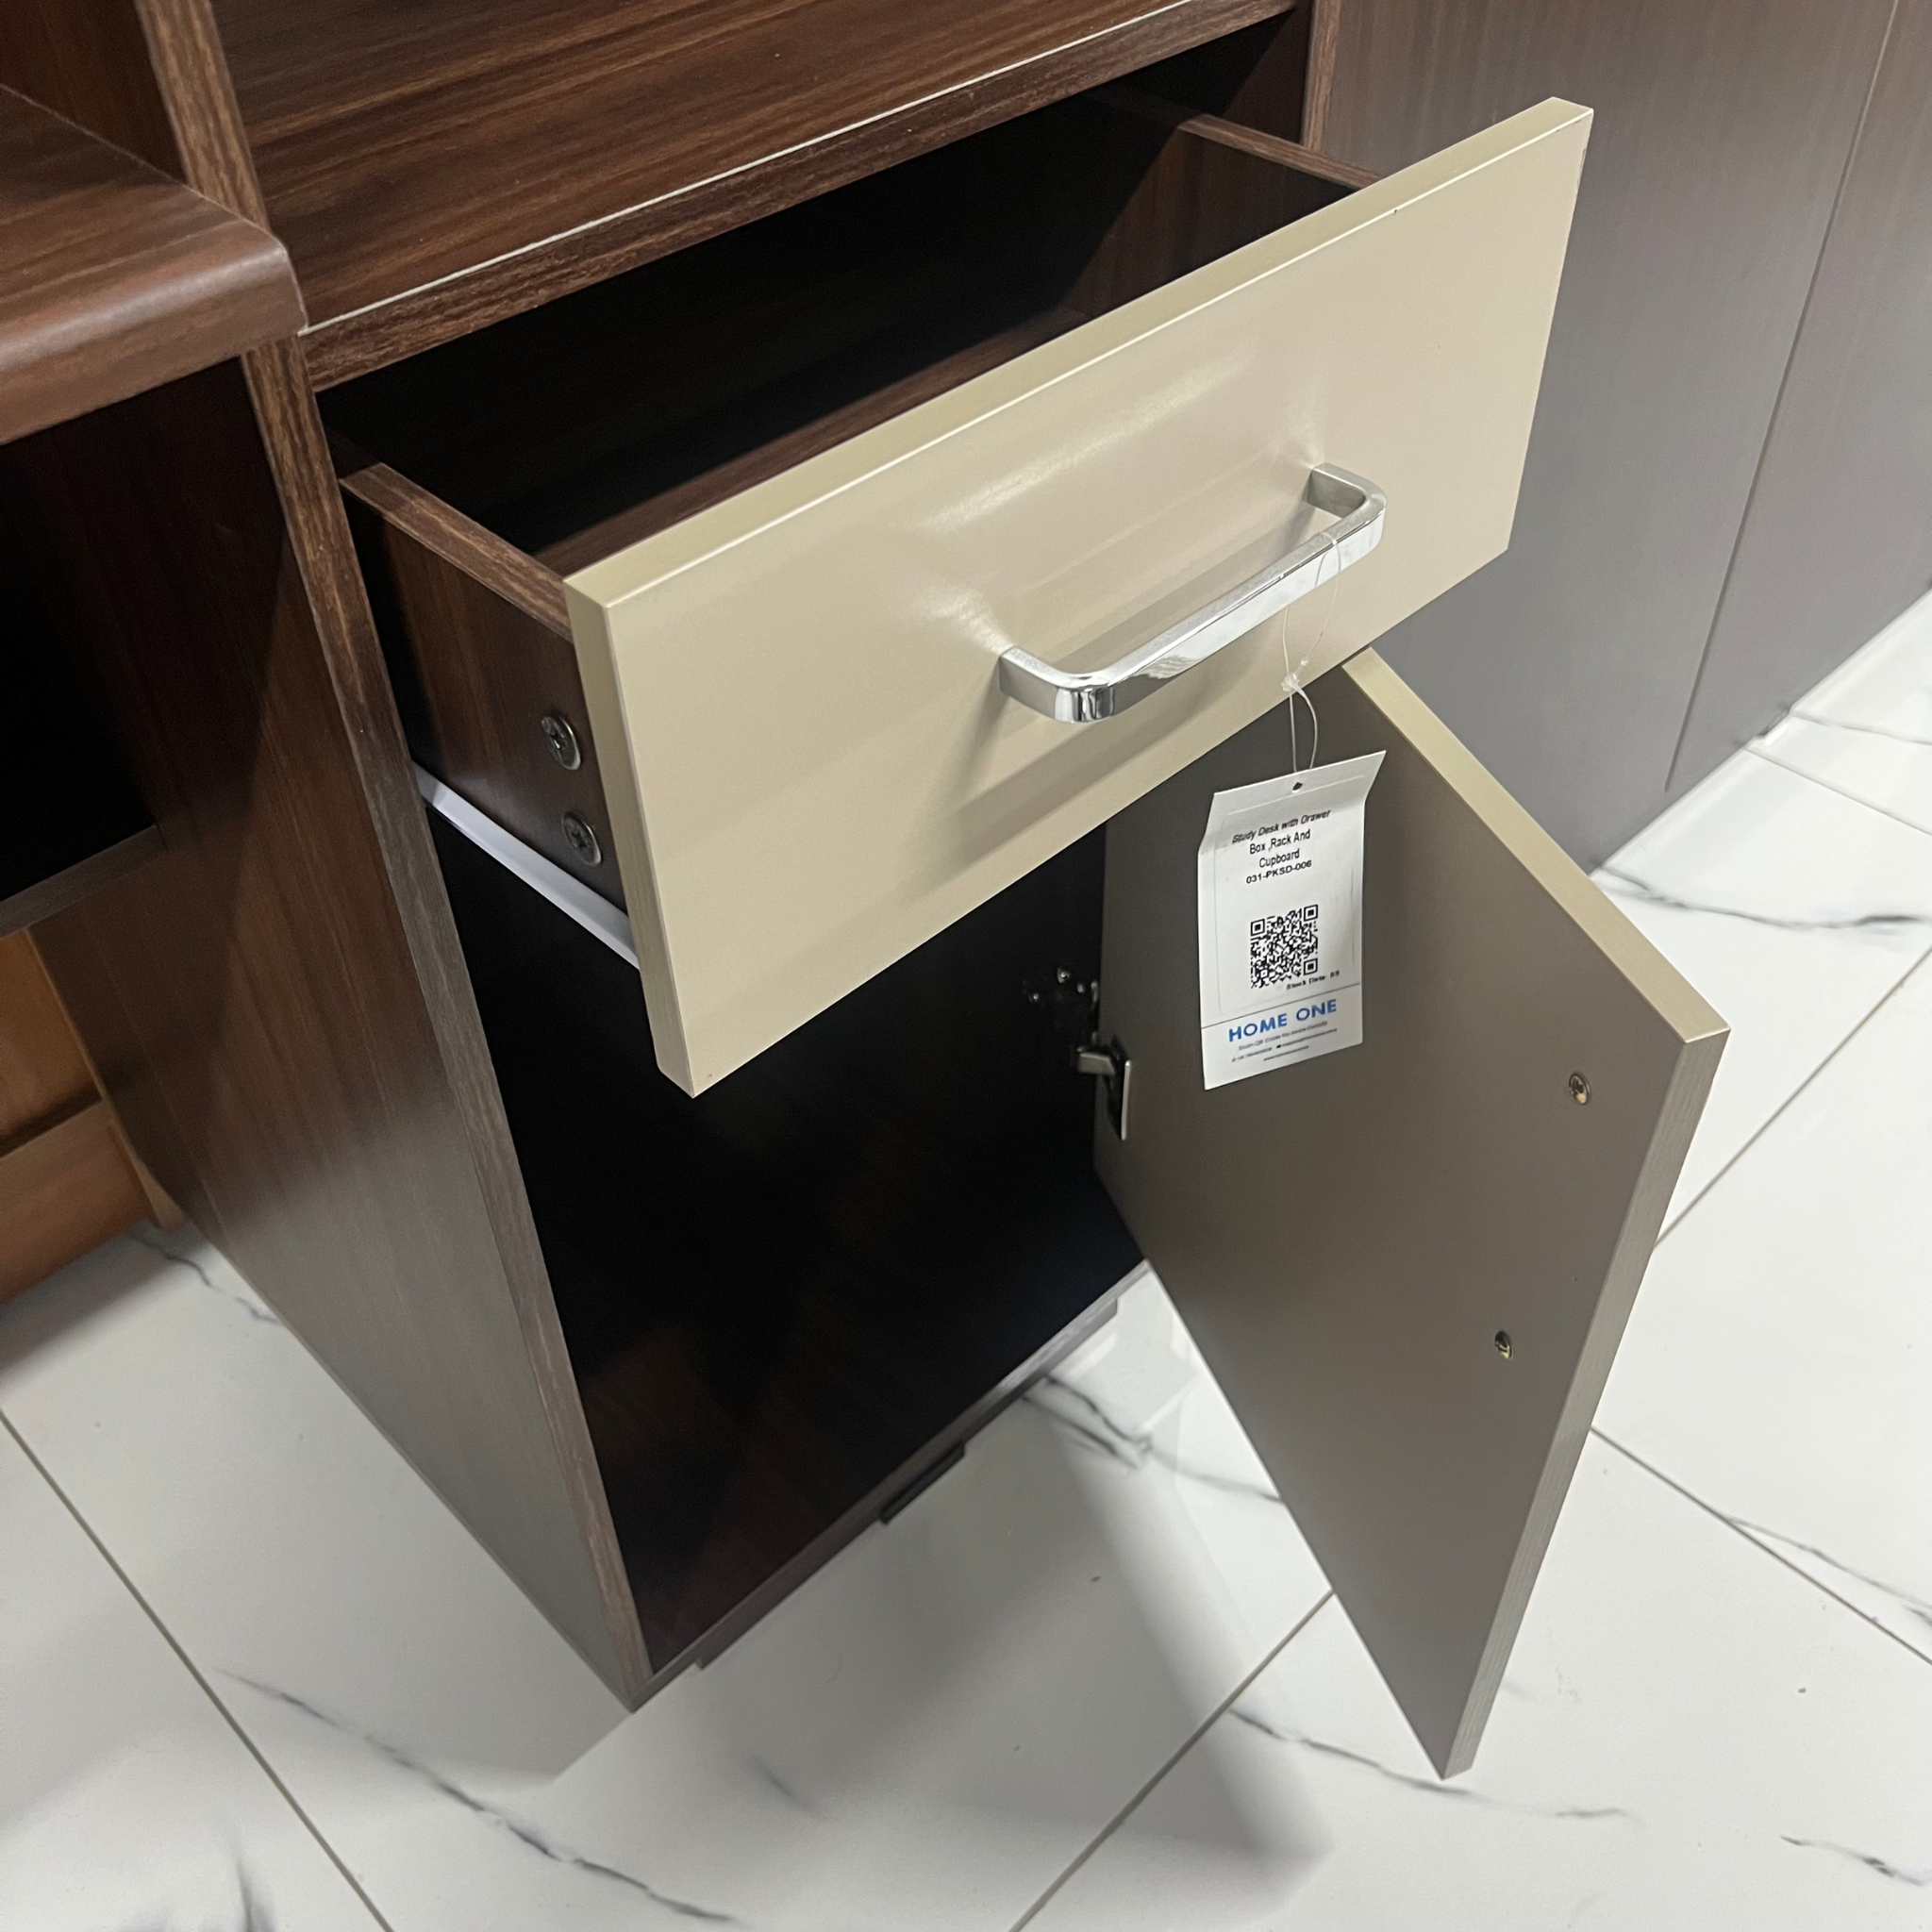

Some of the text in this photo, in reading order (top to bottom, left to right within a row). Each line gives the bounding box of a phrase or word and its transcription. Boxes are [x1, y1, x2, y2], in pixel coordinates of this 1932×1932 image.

[1232, 809, 1331, 844] Study Desk with Drawer
[1249, 842, 1266, 855] Box
[1293, 828, 1310, 842] And
[1258, 847, 1300, 868] Cupboard
[1245, 859, 1312, 884] 031-PKSD-006
[1228, 1012, 1288, 1042] HOME
[1295, 998, 1337, 1022] ONE
